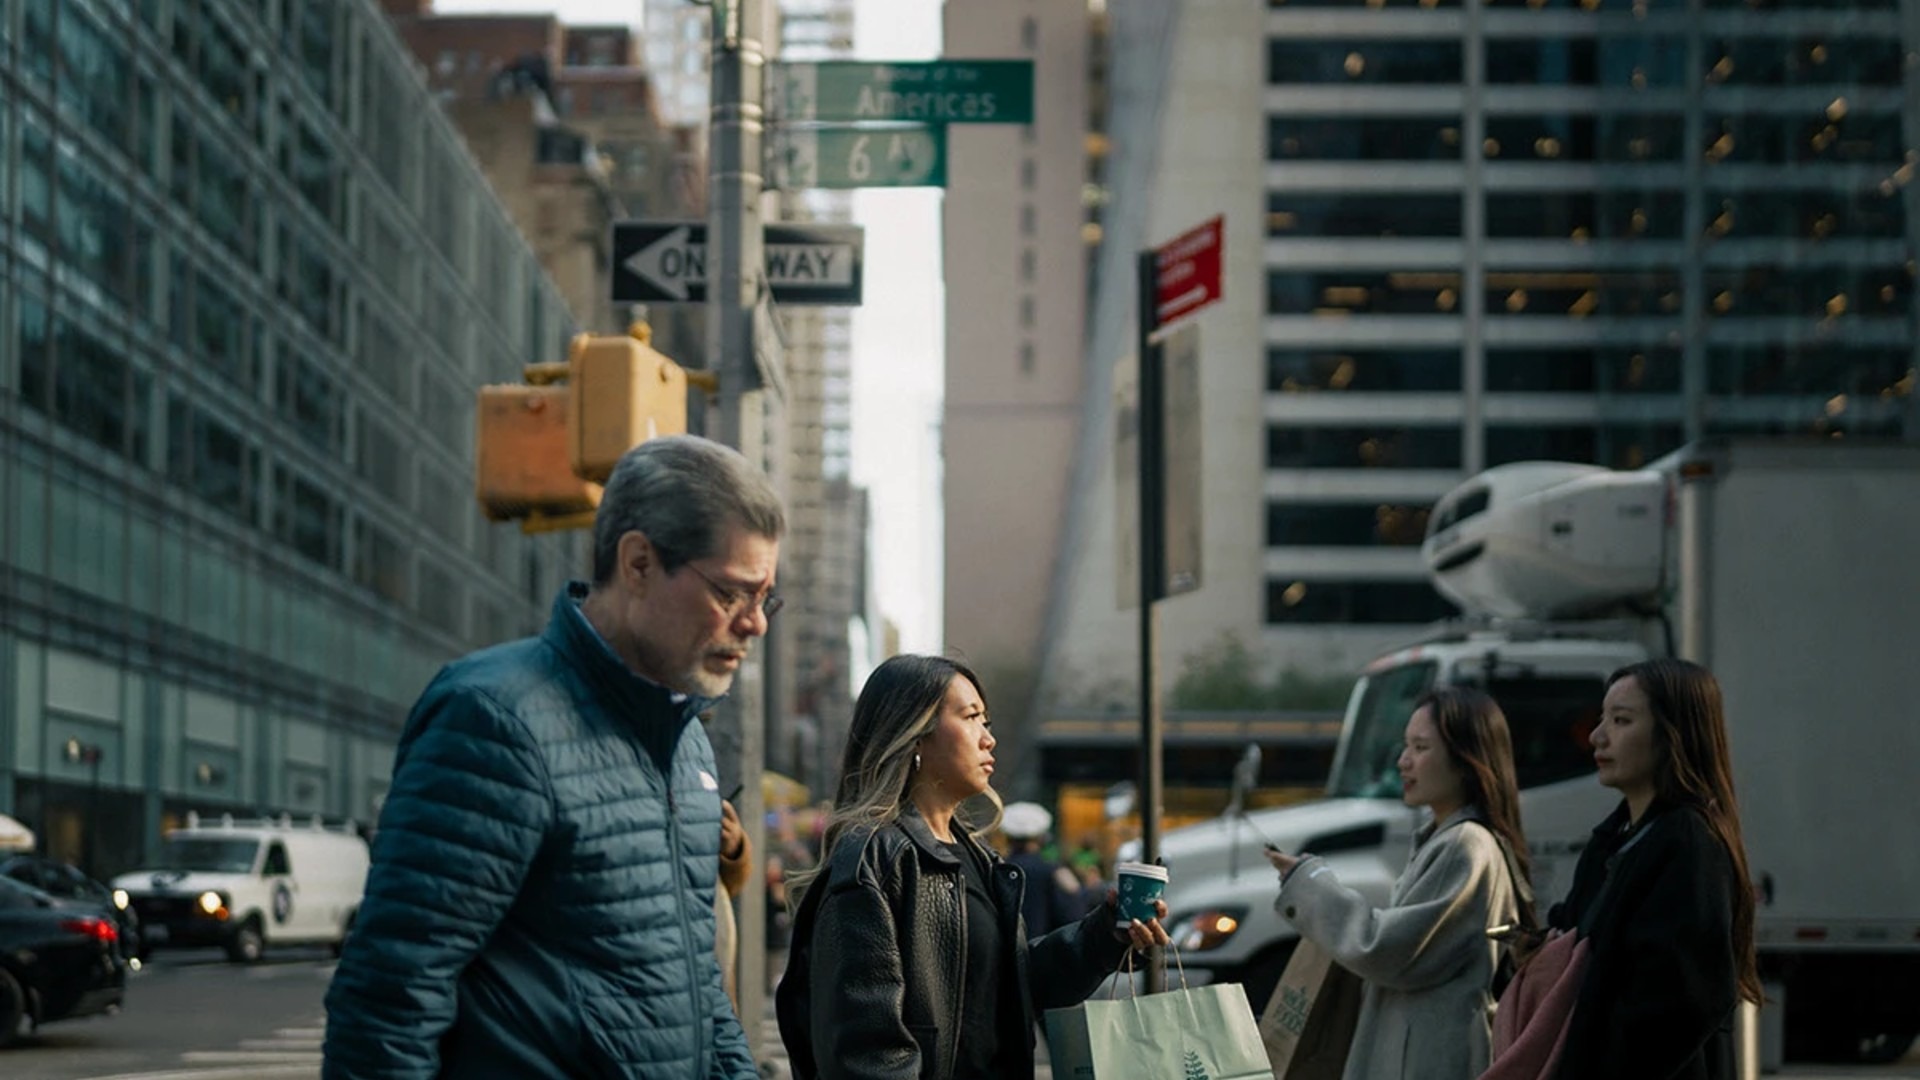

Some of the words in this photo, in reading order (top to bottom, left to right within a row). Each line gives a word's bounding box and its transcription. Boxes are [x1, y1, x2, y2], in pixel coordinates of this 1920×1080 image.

[855, 85, 997, 119] Americas
[848, 135, 871, 182] 6
[659, 247, 707, 279] ON
[767, 248, 836, 280] WAY
